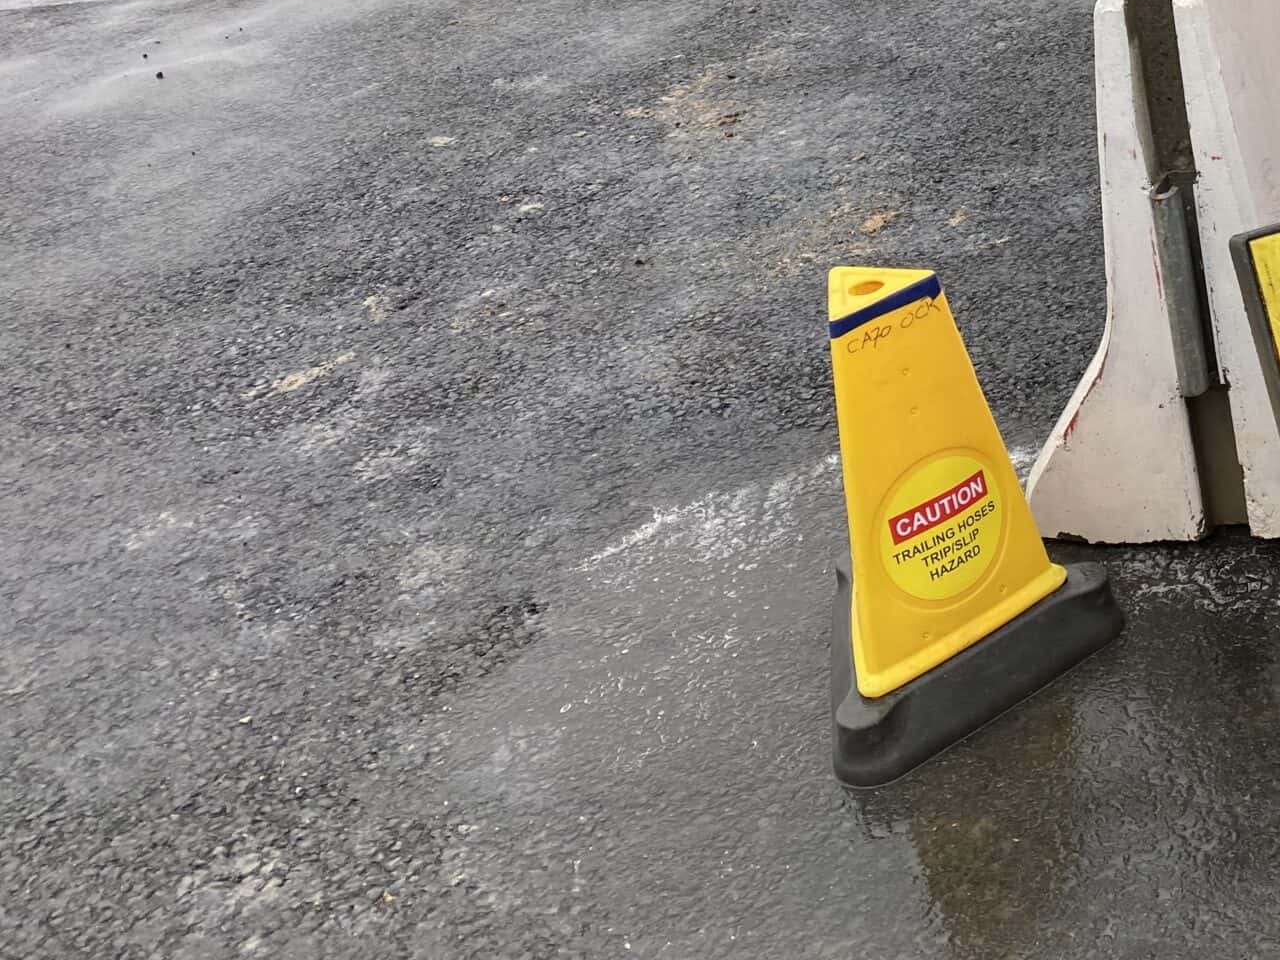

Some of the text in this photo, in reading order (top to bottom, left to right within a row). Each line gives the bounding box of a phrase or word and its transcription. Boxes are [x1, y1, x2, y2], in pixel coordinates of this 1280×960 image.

[847, 325, 892, 354] CA70
[895, 476, 984, 537] CAUTION
[892, 500, 995, 565] TRAILING HOSES
[921, 528, 980, 567] TRIP/SLIP
[930, 544, 981, 581] HAZARD
